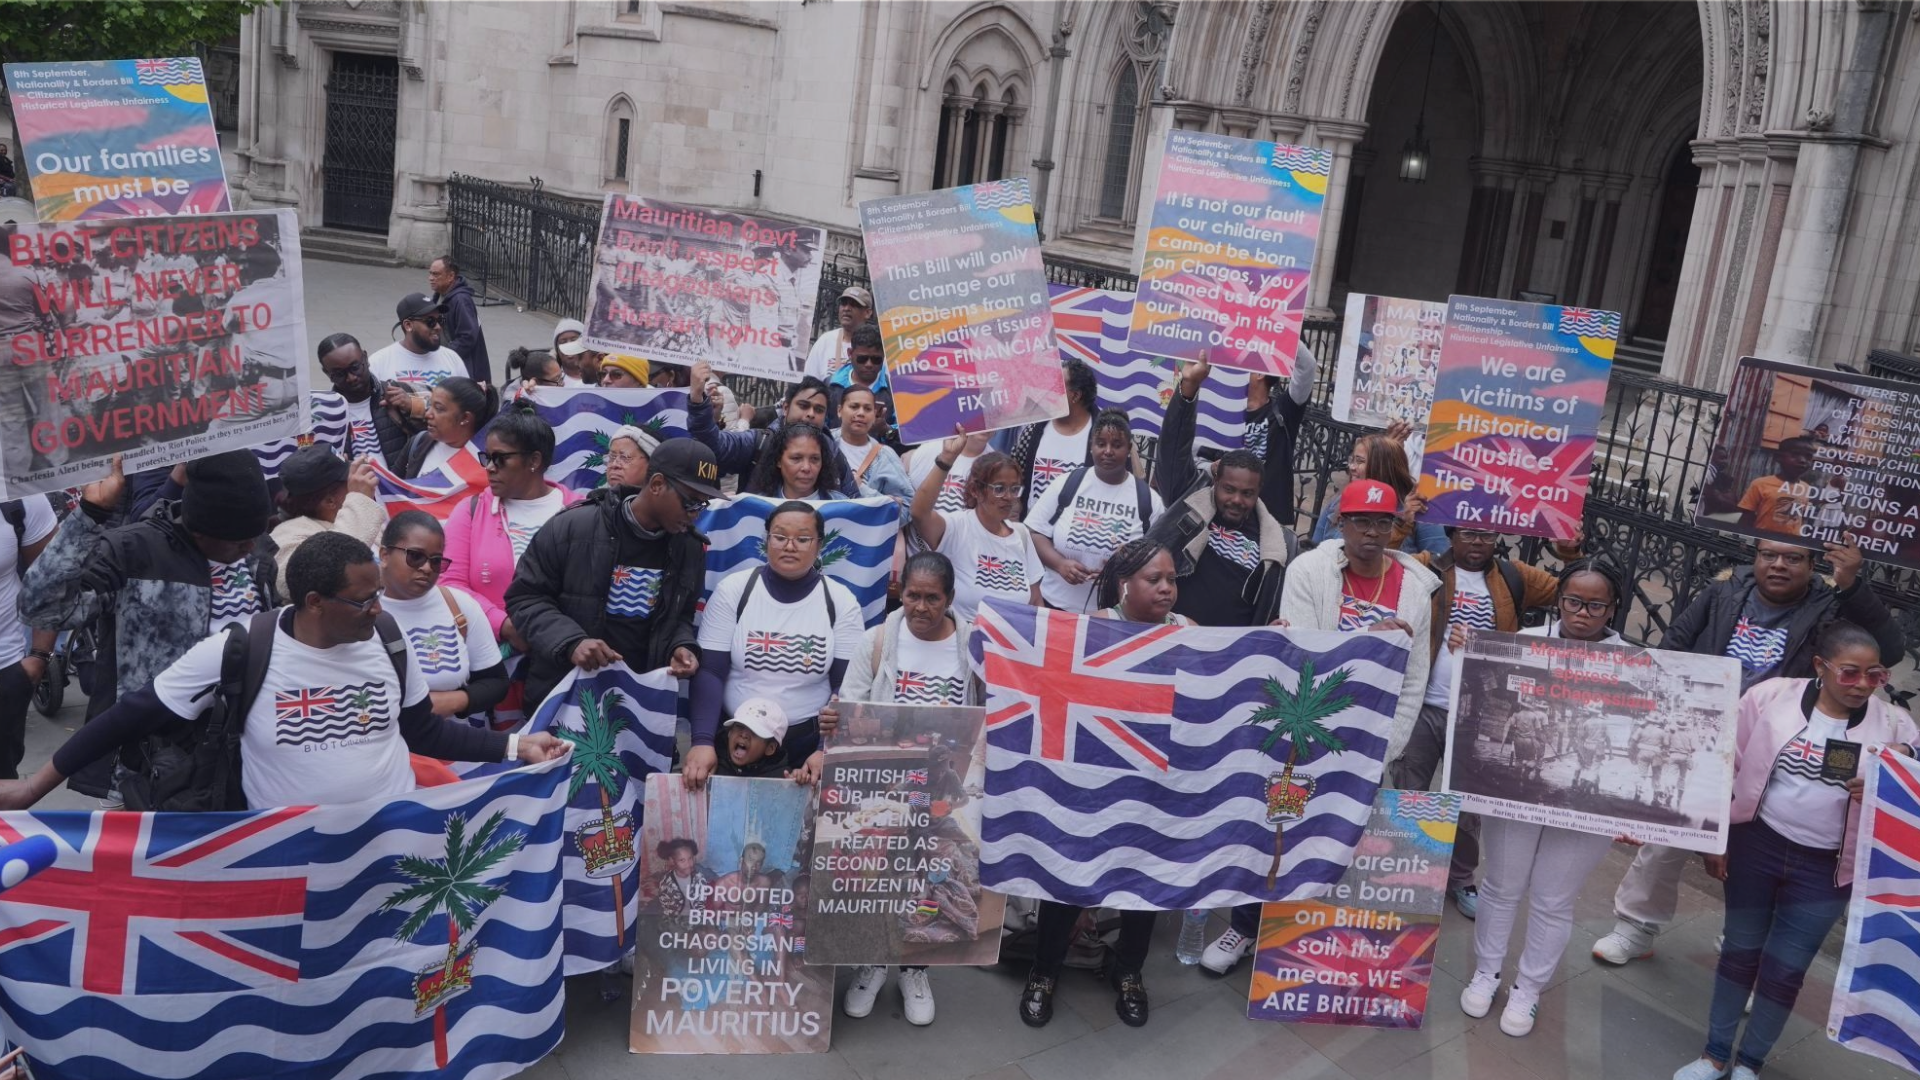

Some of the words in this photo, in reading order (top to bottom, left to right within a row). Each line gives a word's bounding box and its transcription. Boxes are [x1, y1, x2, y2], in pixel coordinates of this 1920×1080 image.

[14, 70, 30, 78] 8th
[17, 81, 70, 89] Nationality
[83, 79, 118, 87] Borders
[121, 77, 133, 85] Bill
[21, 101, 67, 110] Historical
[70, 99, 120, 109] Legislative
[123, 96, 169, 105] Unfairness
[27, 91, 81, 99] Citizenship
[36, 151, 92, 175] Our
[100, 143, 211, 171] families
[73, 181, 143, 203] must
[152, 177, 189, 197] be
[1165, 192, 1177, 205] It
[1182, 194, 1194, 208] is
[1199, 198, 1228, 213] not
[1233, 204, 1261, 217] our
[1265, 206, 1305, 224] fault
[614, 199, 733, 238] Mauritian
[740, 220, 797, 249] Govt
[1178, 217, 1207, 231] our
[1211, 219, 1283, 243] children
[9, 230, 97, 267] BIOT
[111, 218, 260, 258] CITIZENS
[616, 229, 679, 259] Don't
[687, 245, 778, 276] respect
[1159, 236, 1221, 255] cannot
[1226, 242, 1249, 260] be
[1254, 248, 1295, 267] born
[887, 264, 920, 281] This
[925, 257, 950, 275] Bill
[955, 251, 984, 270] will
[990, 245, 1028, 264] only
[1153, 257, 1175, 270] on
[1182, 259, 1253, 286] Chagos,
[1260, 274, 1293, 289] you
[33, 277, 126, 314] WILL
[135, 264, 242, 301] NEVER
[615, 261, 776, 306] Chagossians
[909, 279, 980, 301] change
[987, 273, 1015, 288] our
[1150, 277, 1220, 300] banned
[1224, 289, 1242, 303] us
[1248, 292, 1288, 312] from
[890, 302, 976, 331] problems
[983, 295, 1024, 312] from
[1030, 292, 1041, 305] a
[1146, 300, 1174, 314] our
[1179, 304, 1230, 324] home
[1236, 312, 1251, 327] in
[1256, 316, 1284, 333] the
[1453, 313, 1498, 326] Nationality
[1509, 320, 1540, 329] Borders
[1542, 322, 1554, 330] Bill
[1470, 304, 1518, 317] September,
[12, 310, 225, 366] SURRENDER
[233, 302, 271, 333] TO
[608, 301, 703, 335] Human
[709, 317, 782, 349] rights
[898, 321, 991, 352] legislative
[997, 315, 1041, 334] issue
[1148, 321, 1202, 342] Indian
[1208, 330, 1276, 355] Ocean!
[1458, 324, 1503, 336] Citizenship
[896, 359, 929, 375] into
[937, 355, 948, 369] a
[955, 336, 1054, 365] FINANCIAL
[1450, 334, 1488, 343] Historical
[1490, 337, 1533, 348] Legislative
[1536, 343, 1579, 354] Unfairness
[47, 345, 243, 403] MAURITIAN
[955, 368, 1004, 389] issue.
[1481, 356, 1517, 379] We
[1525, 364, 1566, 383] are
[957, 395, 985, 412] FIX
[990, 389, 1009, 405] IT!
[1356, 378, 1407, 397] MADE
[1854, 385, 1910, 402] THERE'S
[1460, 387, 1544, 411] victims
[1552, 395, 1579, 415] of
[1848, 398, 1902, 416] FUTURE
[31, 383, 269, 454] GOVERNMENT
[1457, 413, 1569, 443] Historical
[168, 440, 183, 451] Riot
[186, 436, 206, 448] Police
[1827, 434, 1913, 457] MAURITIUS
[1838, 424, 1908, 446] CHILDREN
[1453, 443, 1558, 472] Injustice.
[1435, 469, 1474, 491] The
[1483, 476, 1512, 496] UK
[1521, 483, 1569, 502] can
[1812, 461, 1920, 490] PROSTITUTION
[1778, 481, 1901, 515] ADDICTIONS
[1844, 482, 1885, 498] DRUG
[1076, 496, 1136, 519] BRITISH
[1455, 500, 1482, 522] fix
[1490, 505, 1537, 528] this!
[1791, 503, 1866, 529] KILLING
[1872, 519, 1916, 538] OUR
[1550, 684, 1657, 711] Chagossians
[305, 741, 337, 752] BIOT
[834, 768, 905, 783] BRITISH
[1467, 795, 1488, 805] Police
[1489, 798, 1504, 808] with
[1506, 801, 1522, 810] their
[1681, 830, 1717, 841] protesters
[1492, 808, 1515, 820] during
[1530, 815, 1547, 824] 1981
[830, 836, 909, 850] TREATED
[914, 837, 939, 850] AS
[1374, 829, 1419, 839] Unfairness
[814, 857, 888, 871] SECOND
[893, 857, 951, 872] CLASS
[685, 886, 794, 904] UPROOTED
[832, 878, 902, 892] CITIZEN
[907, 880, 925, 892] IN
[1359, 882, 1415, 903] born
[689, 910, 768, 926] BRITISH
[818, 899, 917, 914] MAURITIUS
[1295, 910, 1325, 925] on
[1335, 910, 1402, 931] British
[659, 932, 794, 952] CHAGOSSIAN
[1297, 937, 1343, 958] soil,
[1351, 938, 1390, 959] this
[688, 958, 754, 975] LIVING
[762, 960, 781, 976] IN
[1277, 967, 1358, 986] means
[1368, 969, 1402, 988] WE
[661, 978, 803, 1005] POVERTY
[1263, 993, 1309, 1012] ARE
[1317, 995, 1407, 1018] BRITISH!
[646, 1010, 820, 1036] MAURITIUS
